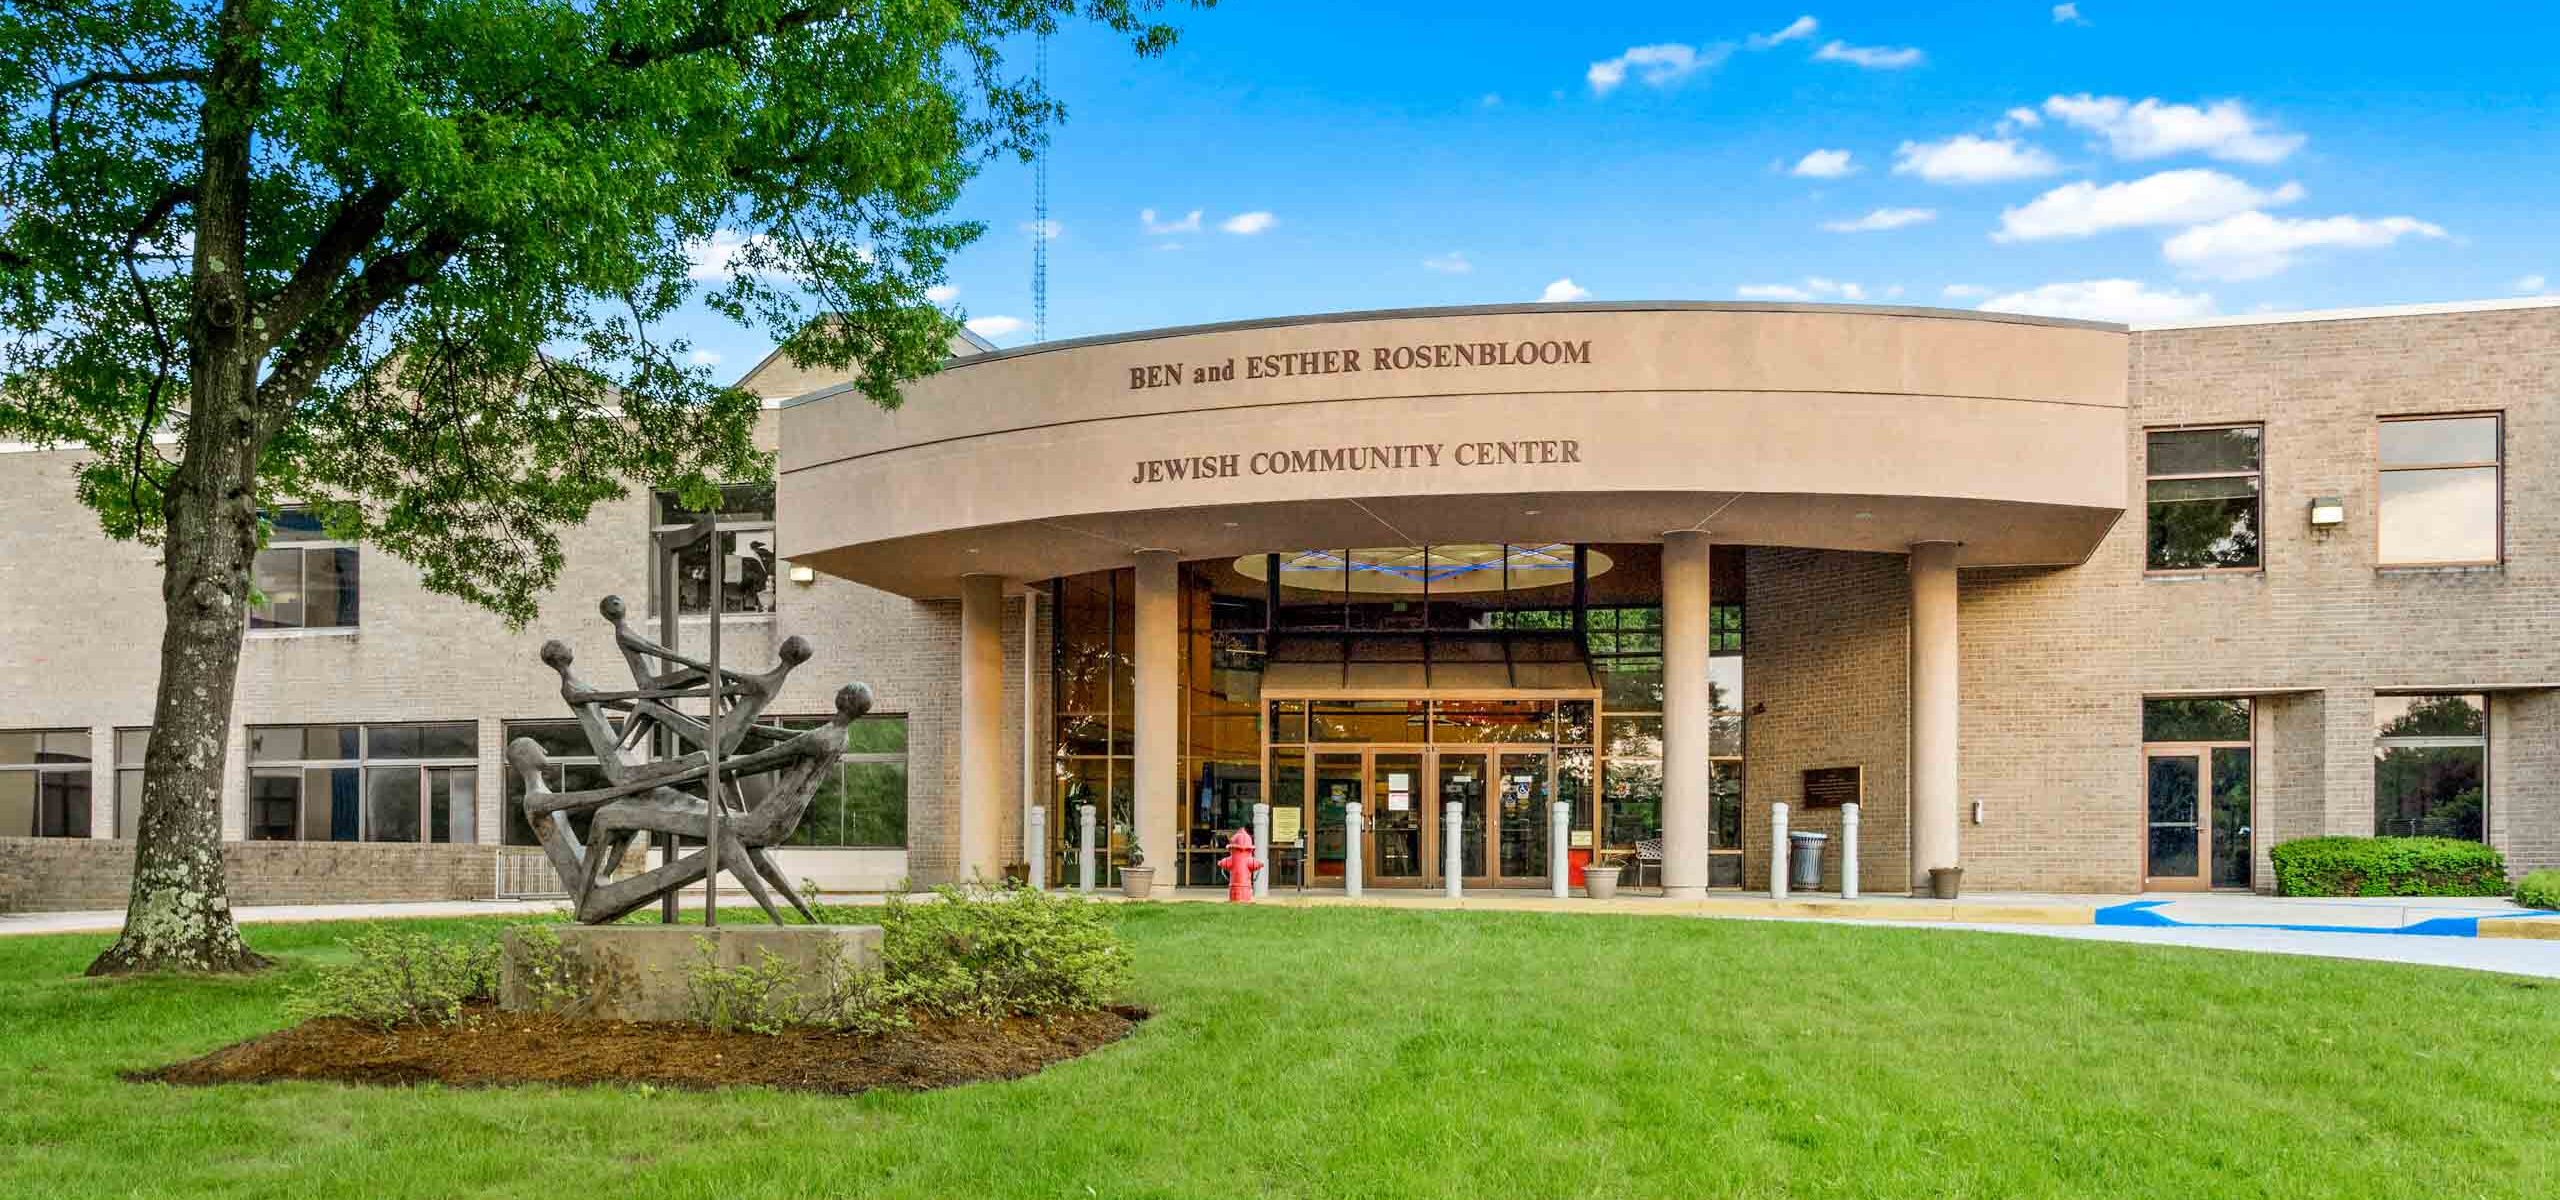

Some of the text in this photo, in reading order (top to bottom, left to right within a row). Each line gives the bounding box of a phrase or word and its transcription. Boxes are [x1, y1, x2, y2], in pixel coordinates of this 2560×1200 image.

[1129, 341, 1592, 389] BEN and ESTHER ROSENBLOOM
[1132, 440, 1582, 484] JEWISH COMMUNITY CENTER
